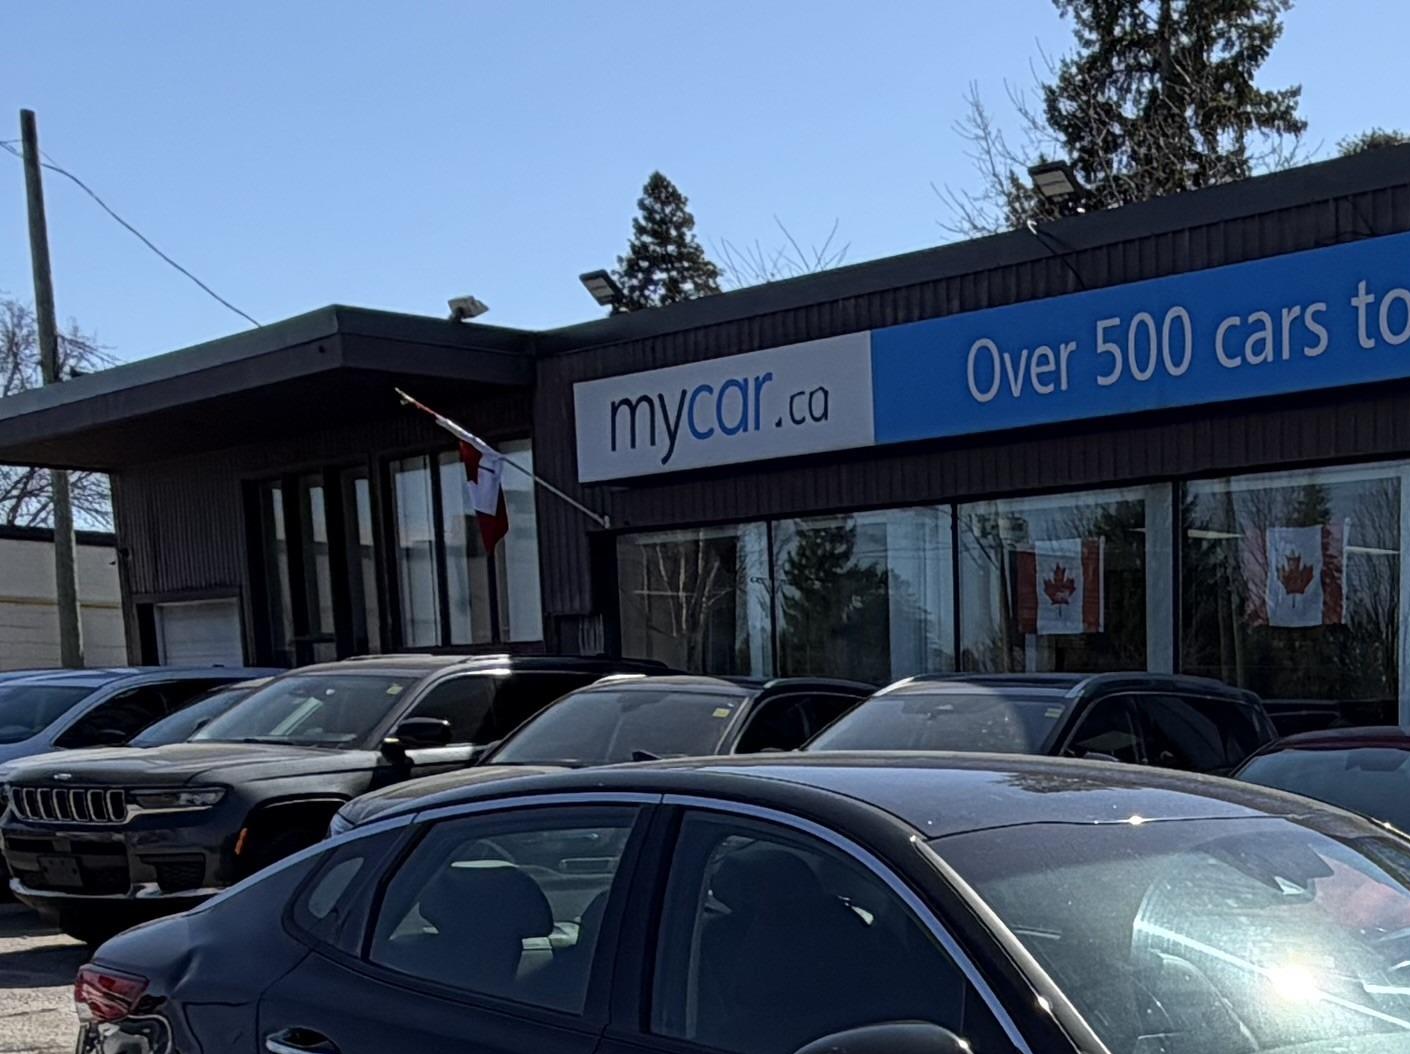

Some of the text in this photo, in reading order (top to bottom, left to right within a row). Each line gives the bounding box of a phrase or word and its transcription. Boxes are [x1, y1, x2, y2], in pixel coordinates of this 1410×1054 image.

[967, 338, 1077, 403] Over
[1096, 306, 1193, 386] 500
[1215, 302, 1329, 368] cars
[610, 371, 829, 466] mycar.ca
